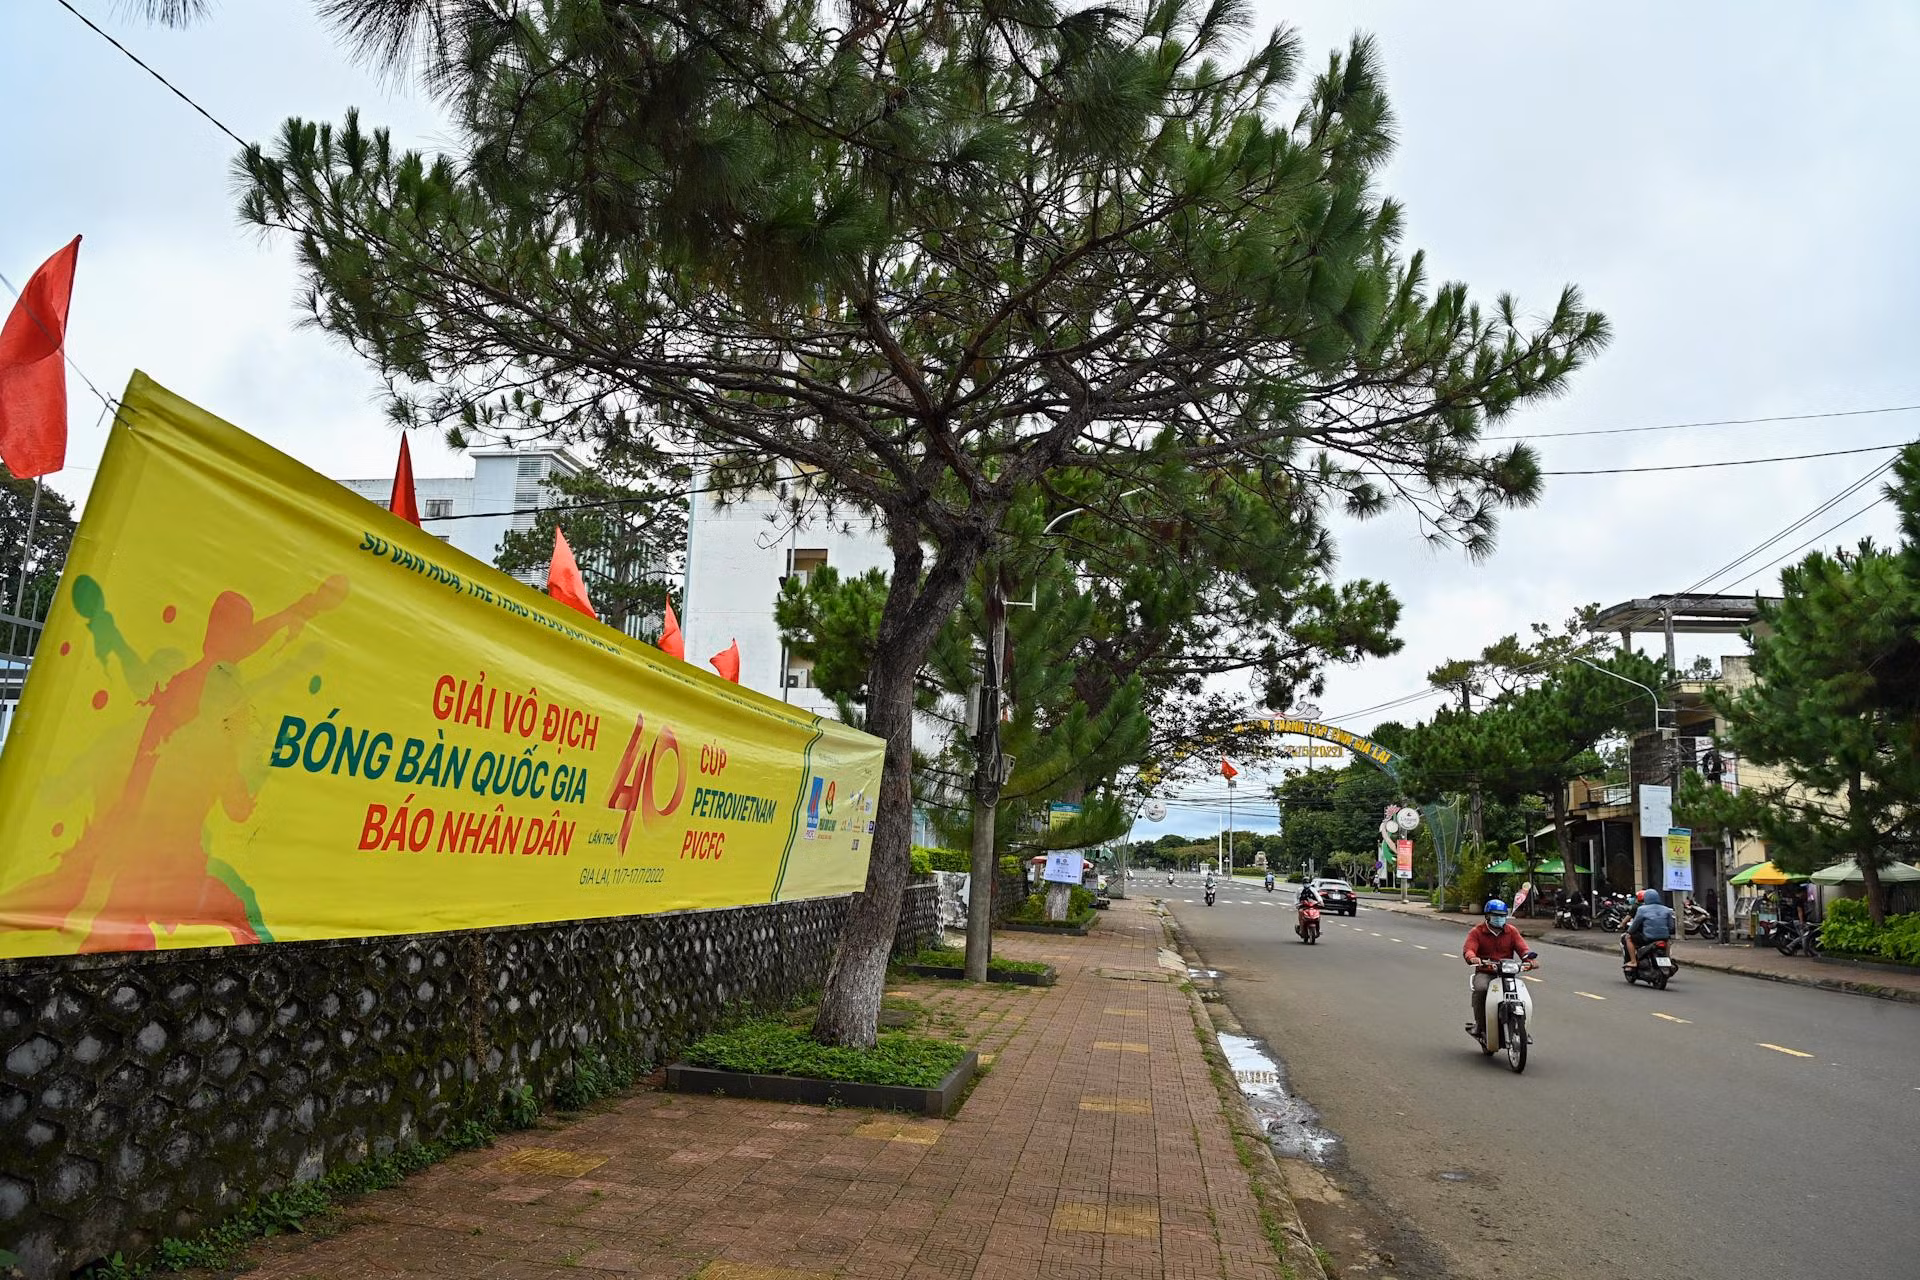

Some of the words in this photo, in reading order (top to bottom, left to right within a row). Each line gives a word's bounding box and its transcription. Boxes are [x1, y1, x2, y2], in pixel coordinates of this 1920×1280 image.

[432, 671, 497, 730] GIẢI
[503, 687, 538, 738] VÔ
[542, 703, 600, 755] ĐỊCH
[270, 708, 393, 780] BÓNG
[395, 728, 472, 789] BÀN
[471, 744, 549, 799] QUỐC
[551, 764, 587, 804] GIA
[700, 739, 727, 776] CÚP
[1372, 746, 1392, 765] LAI
[608, 713, 688, 857] 40
[691, 787, 777, 824] PETROVIETNAM
[357, 793, 435, 853] BÁO
[436, 804, 524, 855] NHÂN
[522, 810, 576, 856] DÂN
[680, 830, 725, 860] PVCFC
[579, 868, 595, 885] GIA
[595, 868, 611, 887] LAI,
[613, 868, 664, 884] 11/7-17/7/2022
